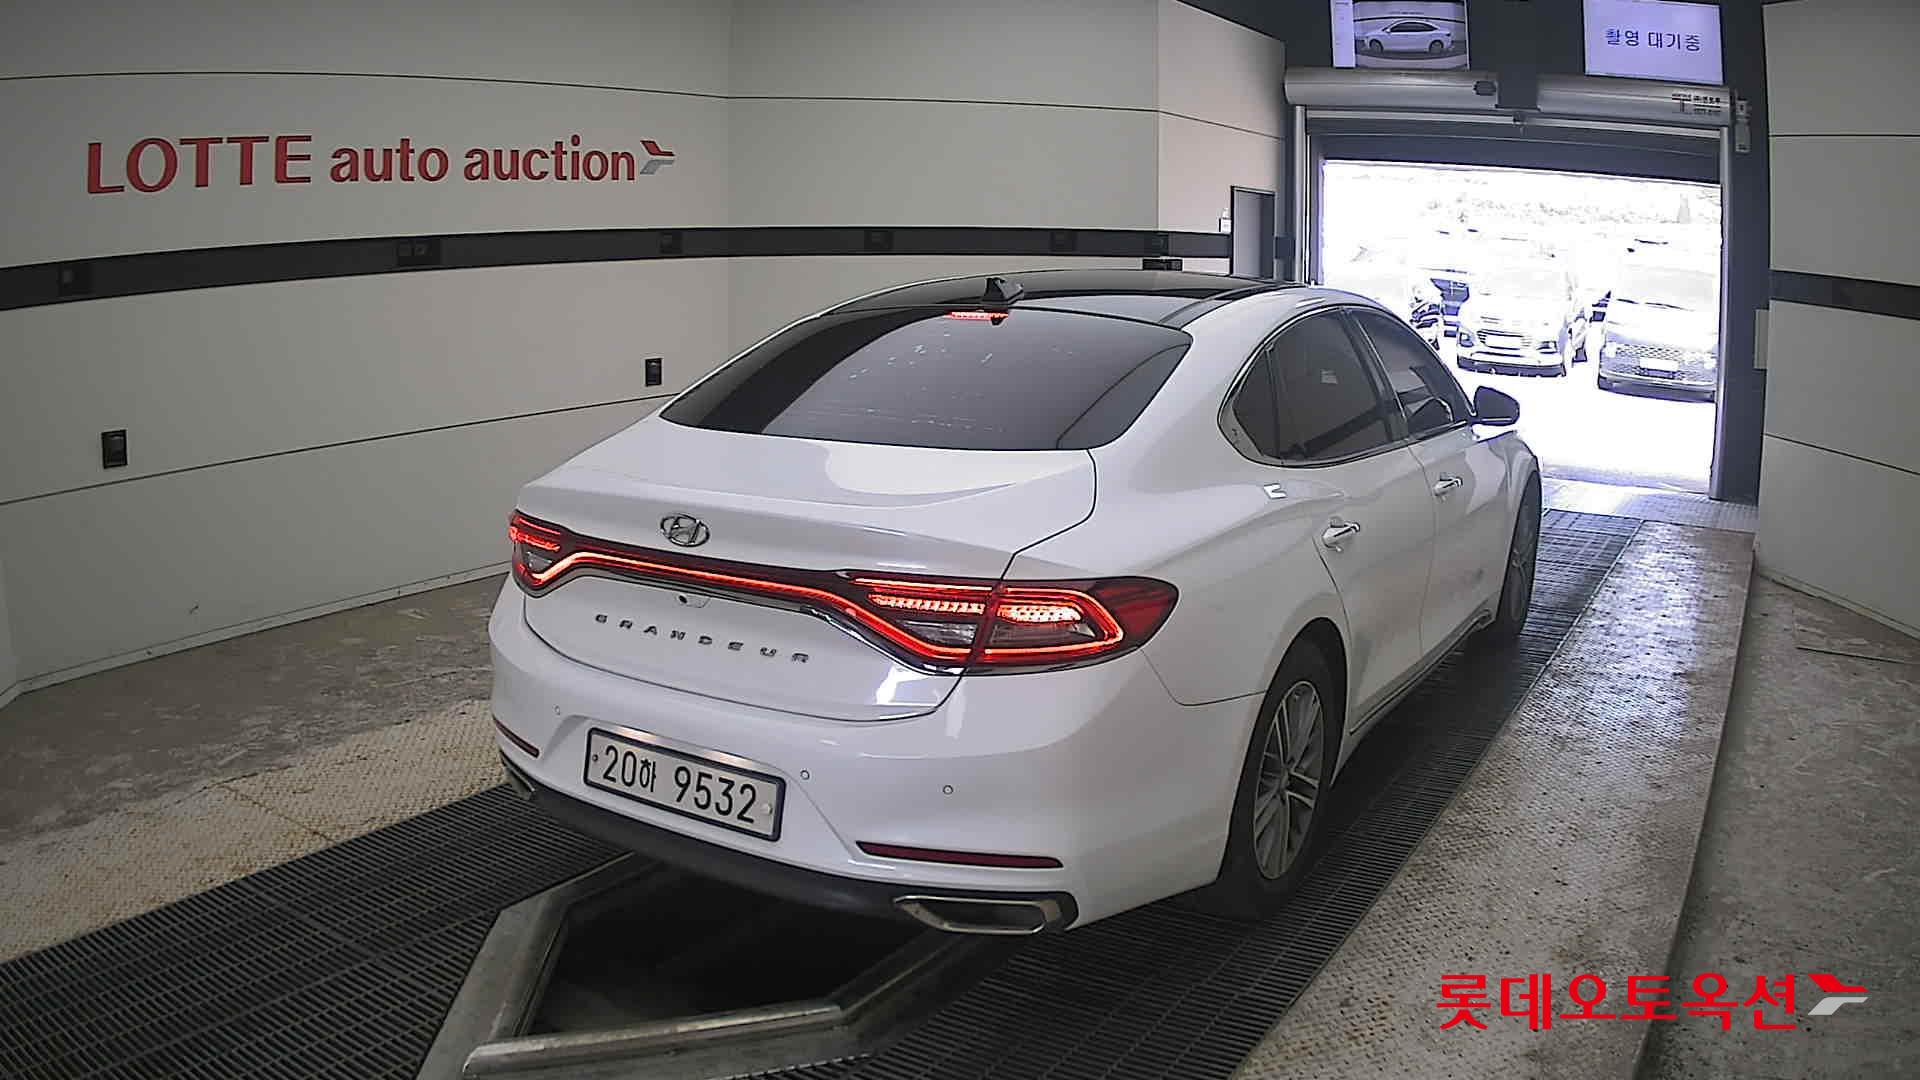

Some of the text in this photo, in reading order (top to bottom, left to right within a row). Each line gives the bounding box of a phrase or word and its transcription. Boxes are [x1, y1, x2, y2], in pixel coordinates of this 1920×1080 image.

[1606, 29, 1639, 46] 촬영
[87, 134, 635, 194] LOTTE auto auction
[595, 613, 809, 664] GRANDEUR
[602, 745, 757, 824] 20하 9532
